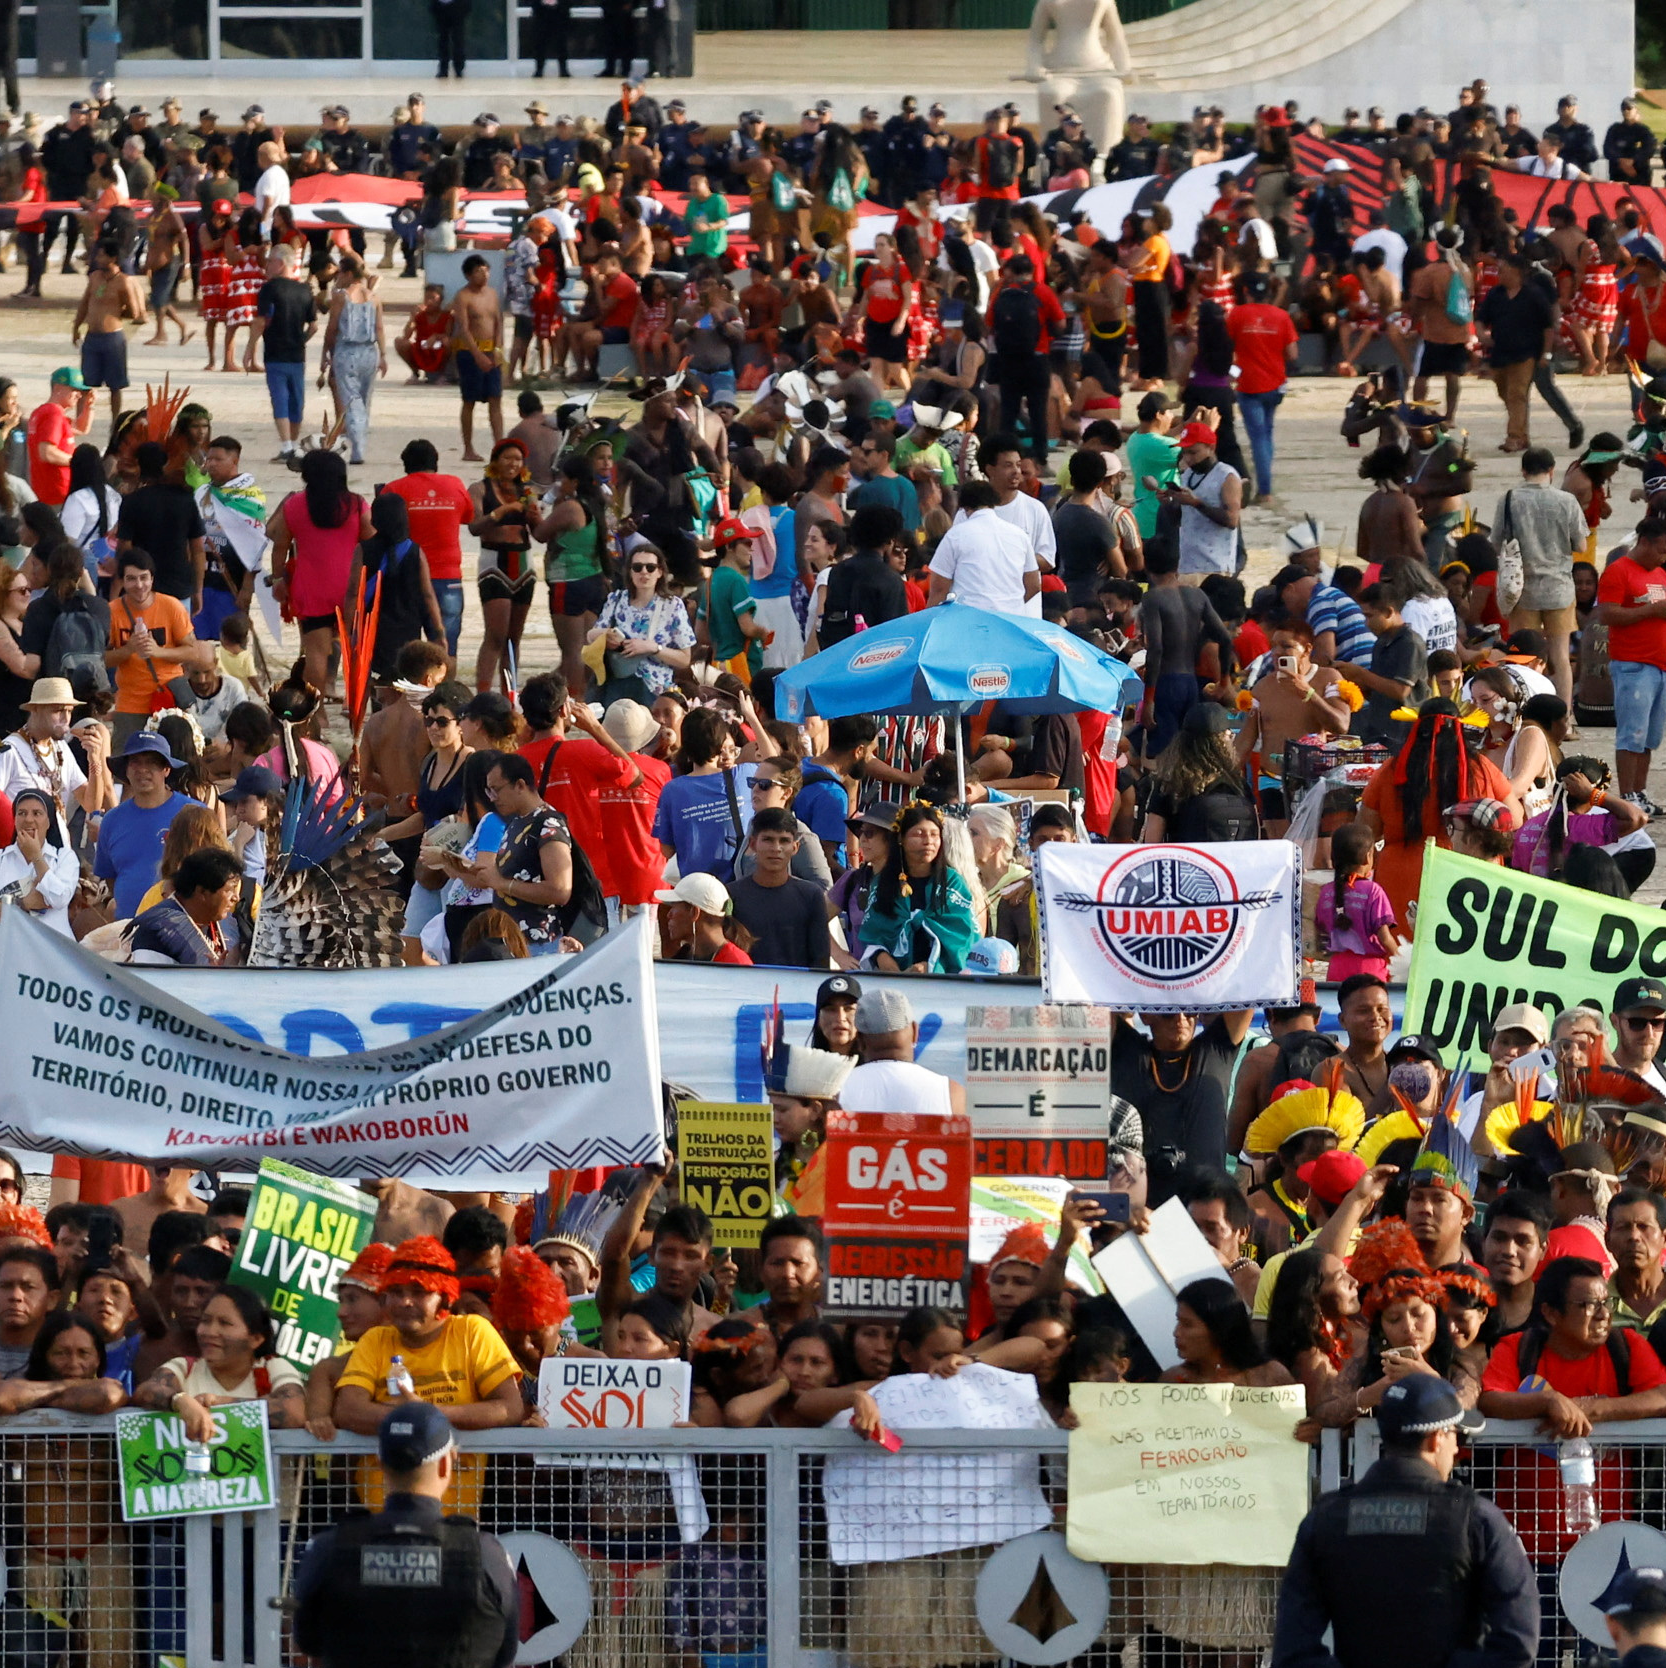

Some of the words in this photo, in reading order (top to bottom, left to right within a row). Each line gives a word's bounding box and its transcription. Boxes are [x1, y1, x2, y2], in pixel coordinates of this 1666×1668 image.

[854, 645, 906, 666] Nestlé
[972, 674, 1008, 689] Nestlé
[1106, 907, 1230, 935] UMIAB
[1435, 877, 1567, 970] SUL
[17, 972, 94, 1013] TODOS
[98, 994, 131, 1022] OS
[459, 1028, 553, 1062] DEFESA
[557, 1024, 593, 1050] DO
[53, 1020, 136, 1063] VAMOS
[140, 1042, 279, 1097] CONTINUAR
[283, 1075, 360, 1103] NOSSA
[967, 1041, 1108, 1079] DEMARCAÇÃO
[30, 1055, 173, 1114] TERRITÓRIO,
[383, 1073, 491, 1108] PRÓPRIO
[497, 1058, 612, 1094] GOVERNO
[1029, 1089, 1046, 1118] É
[293, 1127, 307, 1146] E
[311, 1111, 470, 1144] WAKOBORŨN
[686, 1132, 745, 1146] TRILHOS
[746, 1134, 766, 1146] DA
[686, 1146, 768, 1162] DESTRUIÇÃO
[846, 1139, 949, 1192] GÁS
[973, 1139, 1107, 1179] CERRADO
[685, 1164, 770, 1180] FERROGRÃO
[687, 1179, 772, 1218] NÃO
[989, 1183, 1063, 1194] GOVERNO
[887, 1190, 906, 1219] é
[251, 1184, 360, 1263] BRASIL
[969, 1215, 1033, 1228] TERRA
[239, 1228, 353, 1304] LIVRE
[271, 1287, 305, 1319] DE
[826, 1273, 965, 1309] ENERGÉTICA
[563, 1363, 640, 1388] DEIXA
[645, 1366, 662, 1389] O
[1099, 1386, 1142, 1408] NÓS
[1161, 1385, 1208, 1403] POVOS
[1220, 1384, 1299, 1404] INDÍGENAS
[1109, 1424, 1146, 1446] NÃO
[1154, 1426, 1243, 1442] ACEITAMOS
[133, 1443, 259, 1485] SOOS
[1139, 1443, 1249, 1470] FERROGRÃO
[1134, 1478, 1161, 1496] EM
[1180, 1475, 1242, 1491] NOSSOS
[133, 1487, 150, 1515] A
[1156, 1492, 1257, 1517] TERRITÓRIOS
[1350, 1499, 1423, 1518] POLÍCIA
[363, 1550, 438, 1568] POLÍCIA
[362, 1567, 439, 1584] MILITAR
